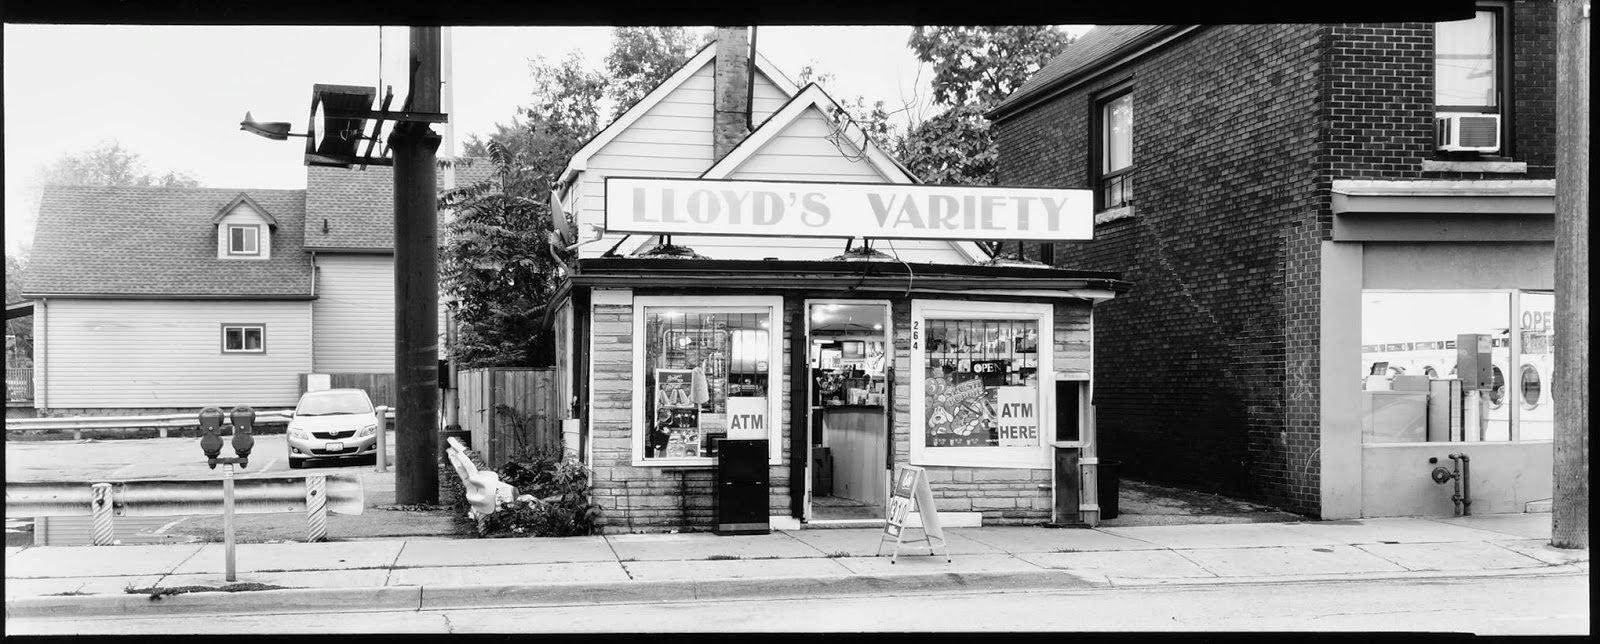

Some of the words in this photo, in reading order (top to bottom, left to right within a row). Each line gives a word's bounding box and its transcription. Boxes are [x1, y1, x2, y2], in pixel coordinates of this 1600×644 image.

[632, 187, 831, 228] LLOYD'S
[867, 192, 1069, 232] VARIETY
[1522, 311, 1552, 330] OPE
[974, 363, 1002, 373] OPEN
[946, 381, 982, 398] SLUSH
[1001, 403, 1033, 418] ATM
[731, 414, 763, 430] ATM
[1000, 425, 1037, 439] HERE
